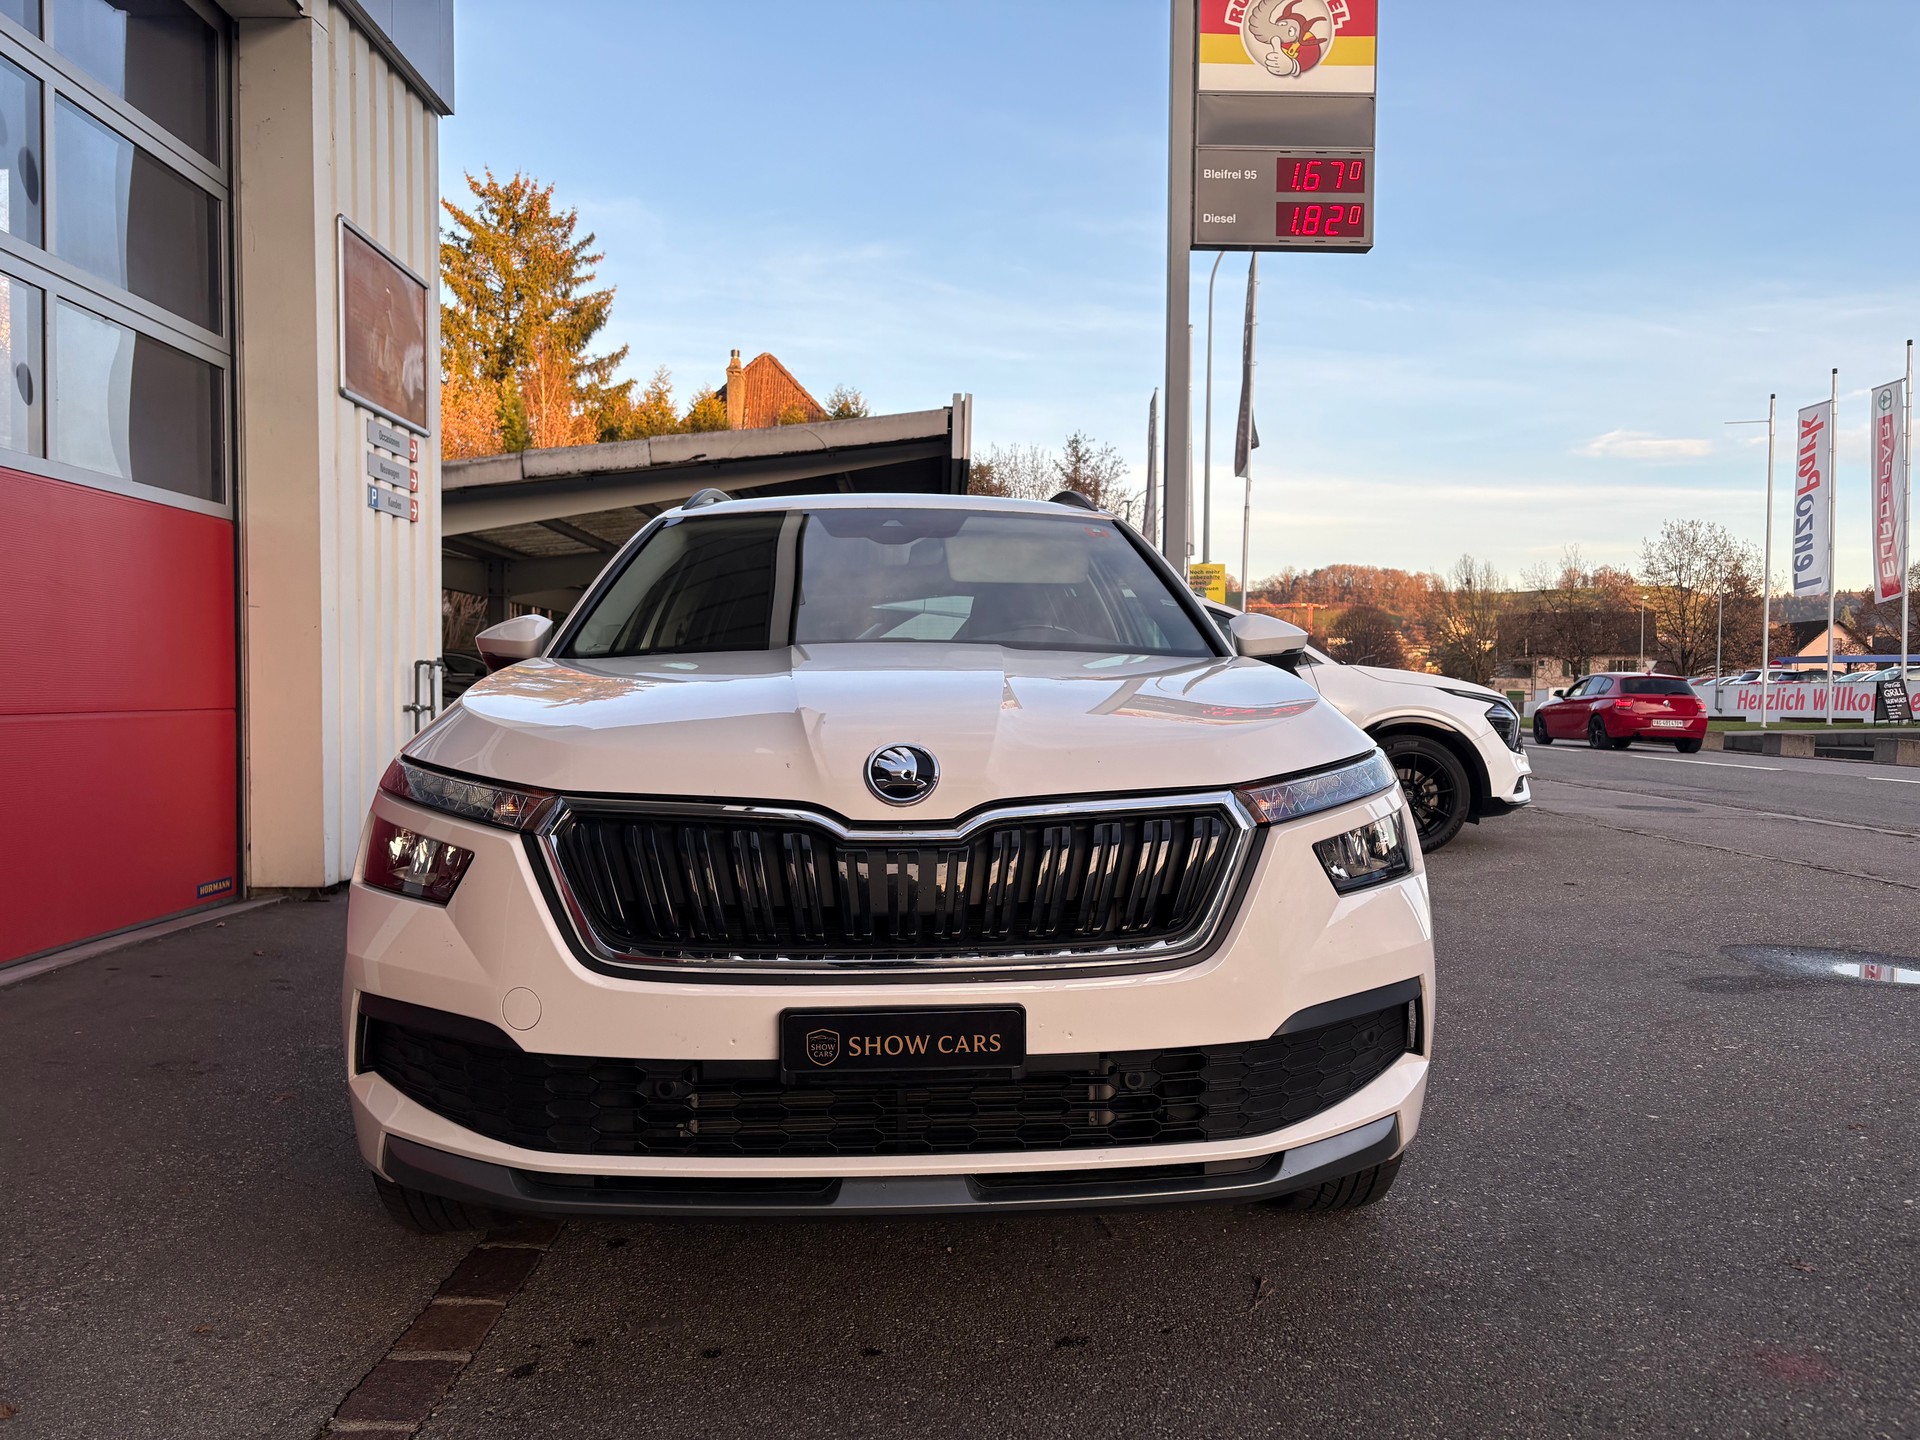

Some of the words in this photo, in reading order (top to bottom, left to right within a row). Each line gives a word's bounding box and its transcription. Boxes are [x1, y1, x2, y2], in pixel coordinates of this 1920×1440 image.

[1203, 169, 1242, 180] Bleifrei
[1244, 170, 1257, 180] 95
[1203, 213, 1236, 224] Diesel
[387, 496, 402, 510] Kunden
[1737, 687, 1805, 711] Herzlich
[810, 1043, 836, 1051] SHOW
[848, 1035, 931, 1057] SHOW
[937, 1034, 1002, 1054] CARS
[813, 1050, 834, 1058] CARS
